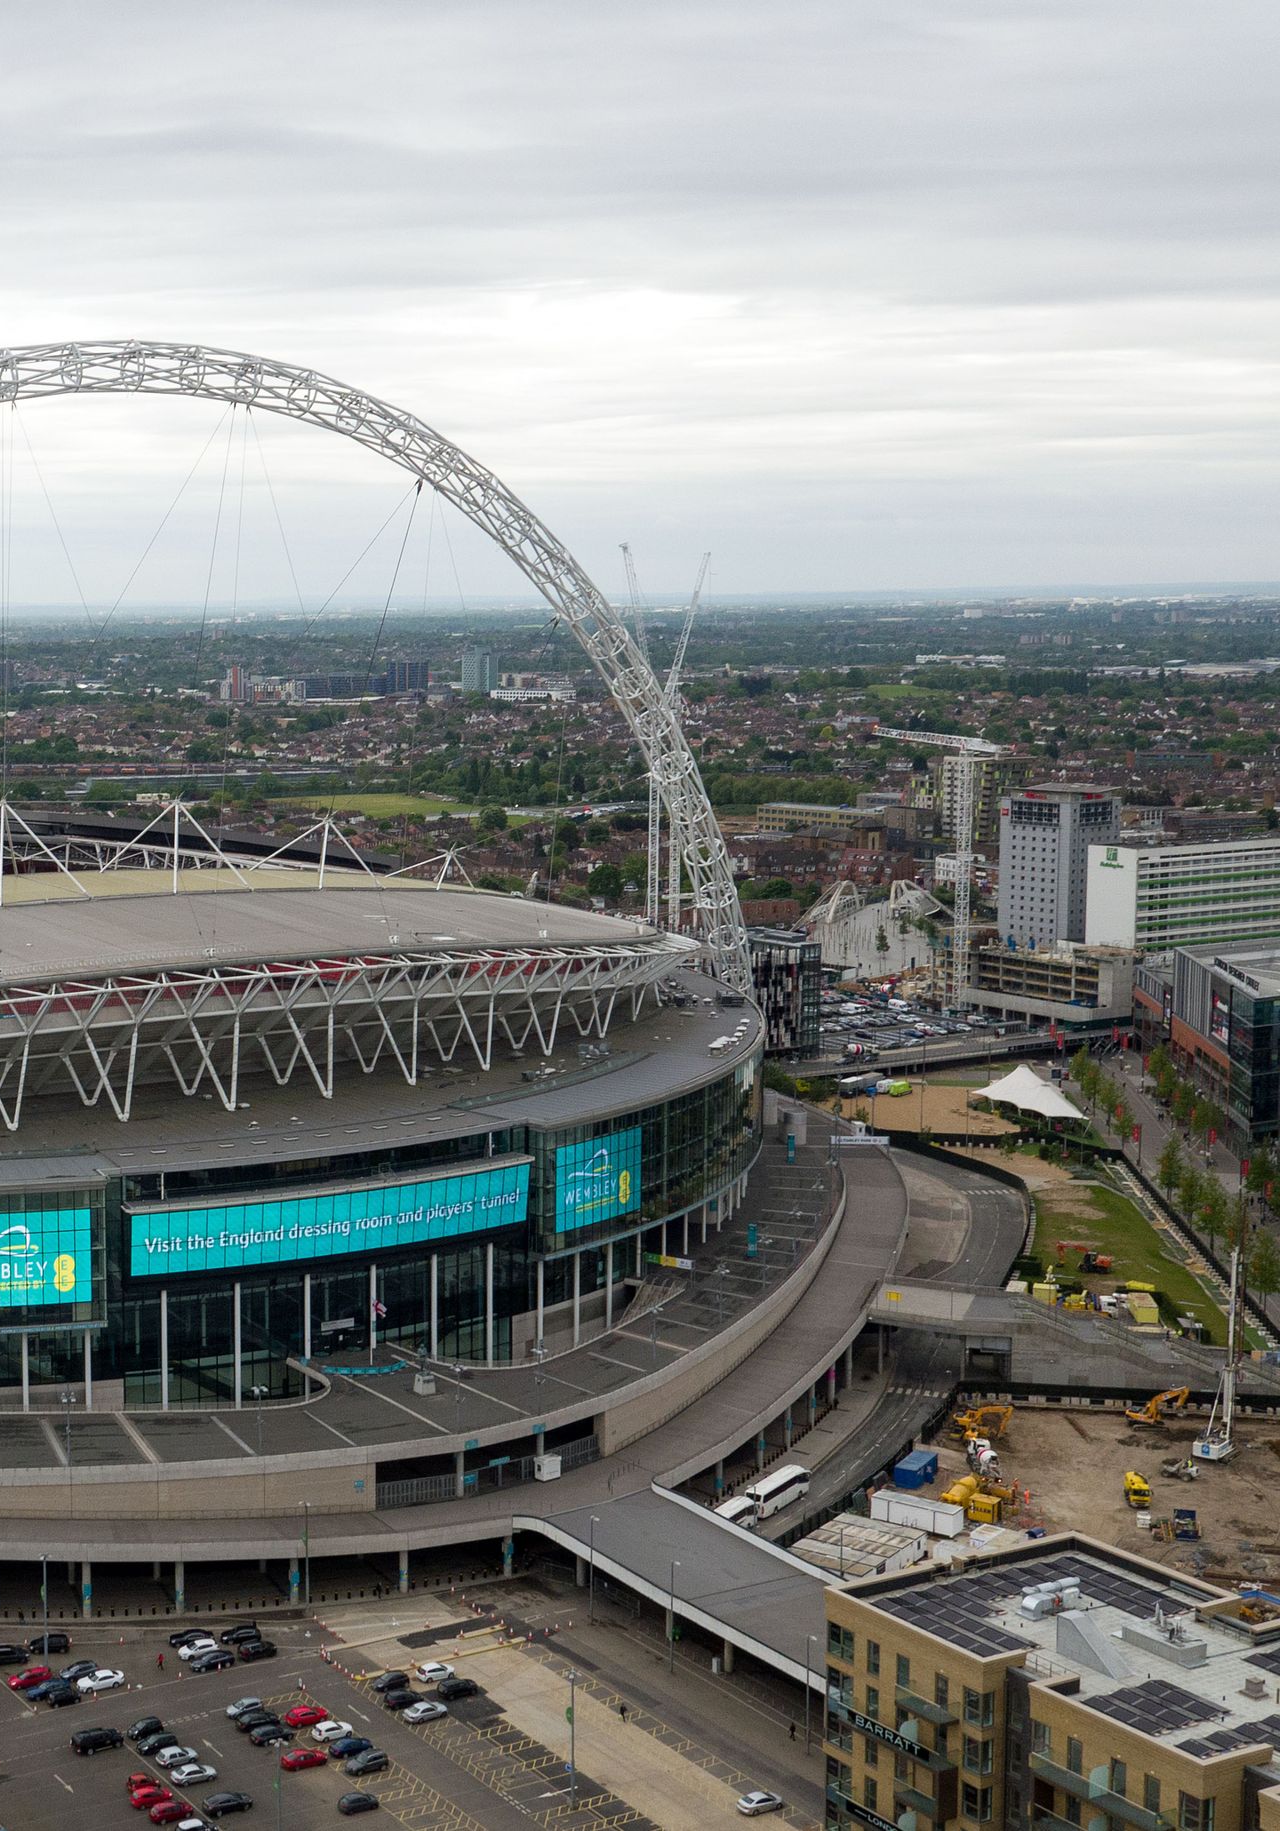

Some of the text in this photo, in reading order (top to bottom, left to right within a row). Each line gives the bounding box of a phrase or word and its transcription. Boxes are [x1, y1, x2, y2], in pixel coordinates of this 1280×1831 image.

[564, 1178, 617, 1206] WEMBLEY
[145, 1236, 183, 1254] Visit
[187, 1234, 215, 1250] the
[220, 1227, 284, 1249] England
[288, 1219, 351, 1237] dressing
[355, 1214, 392, 1231] room
[396, 1206, 423, 1225] and
[481, 1188, 520, 1210] tunnel
[855, 1715, 921, 1756] BARRATT
